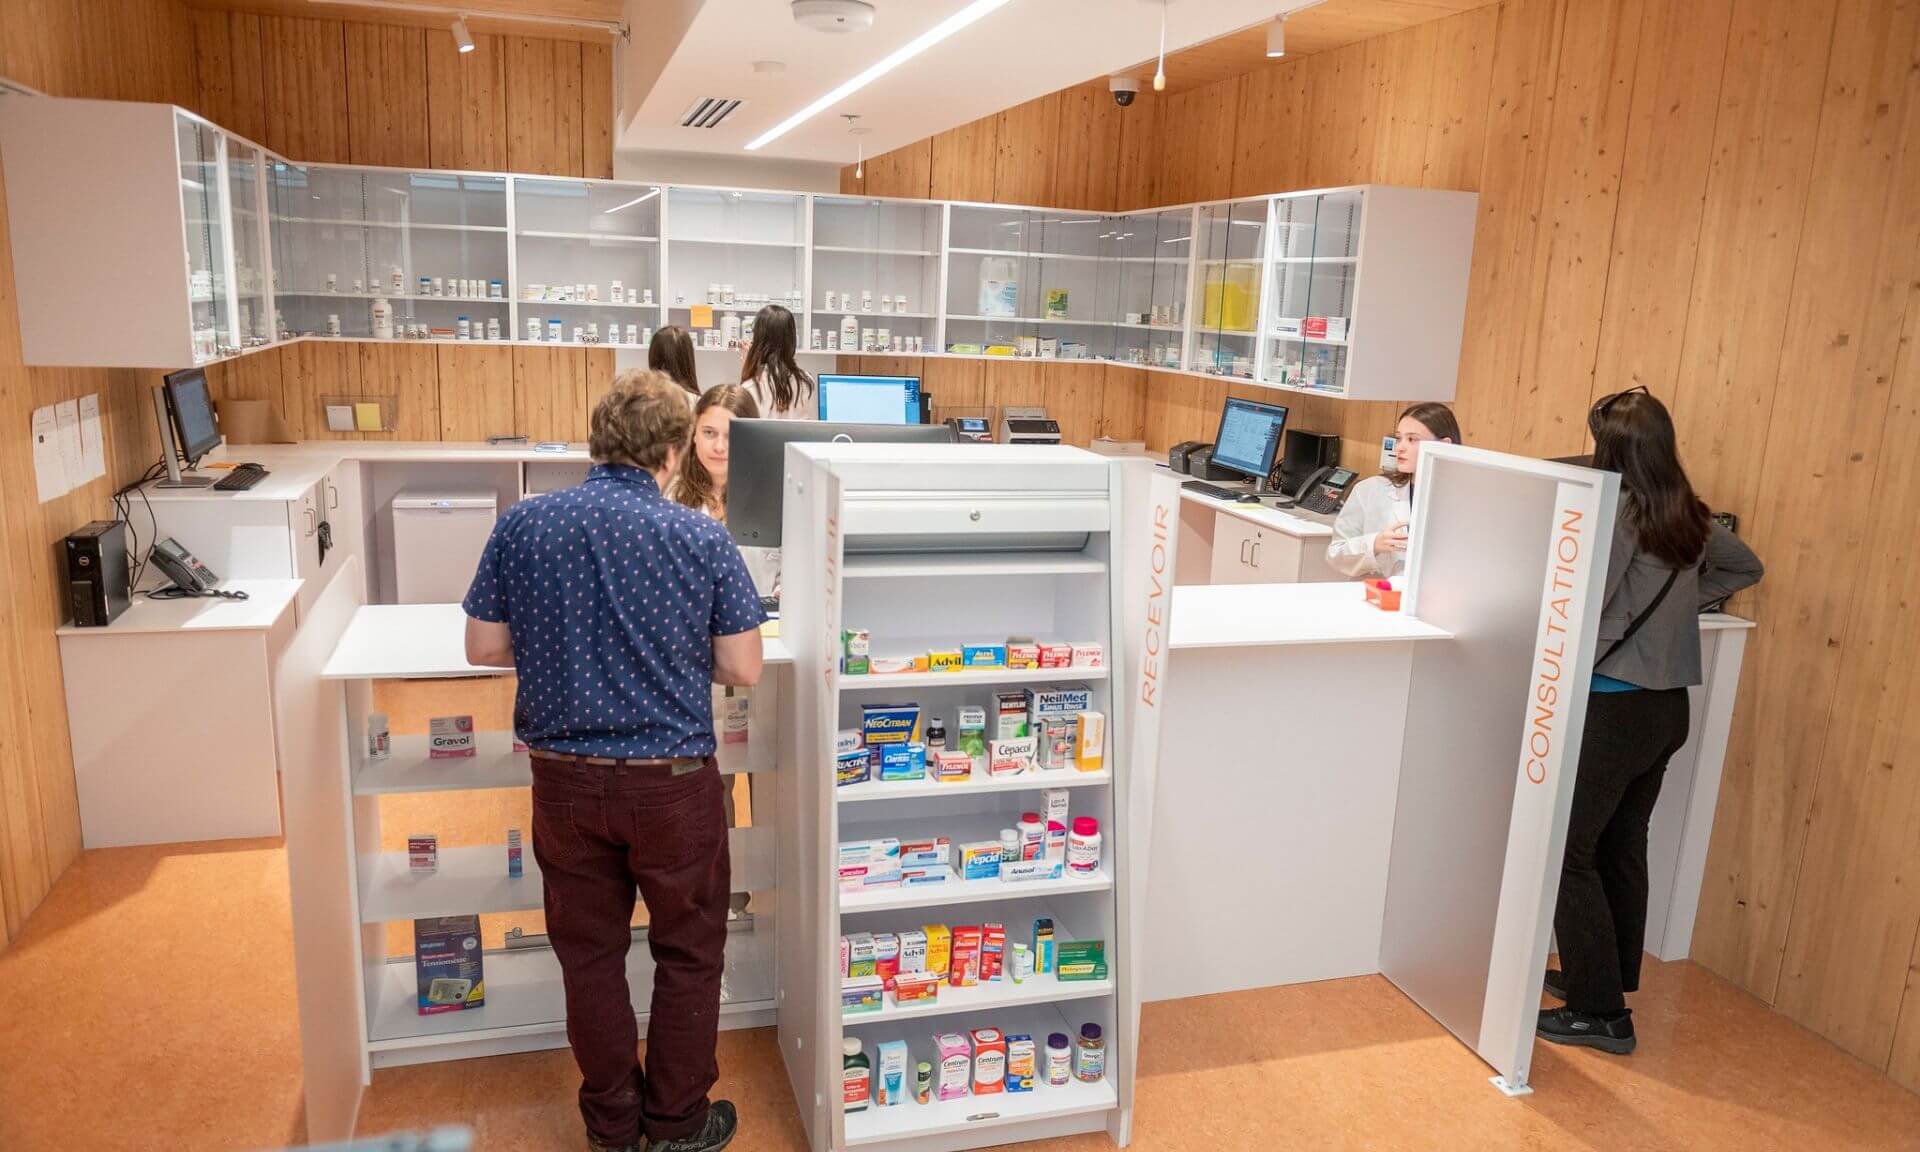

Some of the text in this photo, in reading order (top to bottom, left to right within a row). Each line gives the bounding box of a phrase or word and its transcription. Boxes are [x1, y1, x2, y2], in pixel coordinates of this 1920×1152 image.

[1142, 504, 1168, 708] RECEVOIR
[1526, 508, 1583, 785] CONSULTATION
[934, 657, 961, 667] Advil
[1039, 693, 1088, 704] NeilMed
[433, 737, 471, 747] Gravol
[968, 853, 999, 866] Pepcid
[903, 948, 925, 958] Advil
[943, 1059, 969, 1067] Centrum
[977, 1056, 1005, 1065] Centrum
